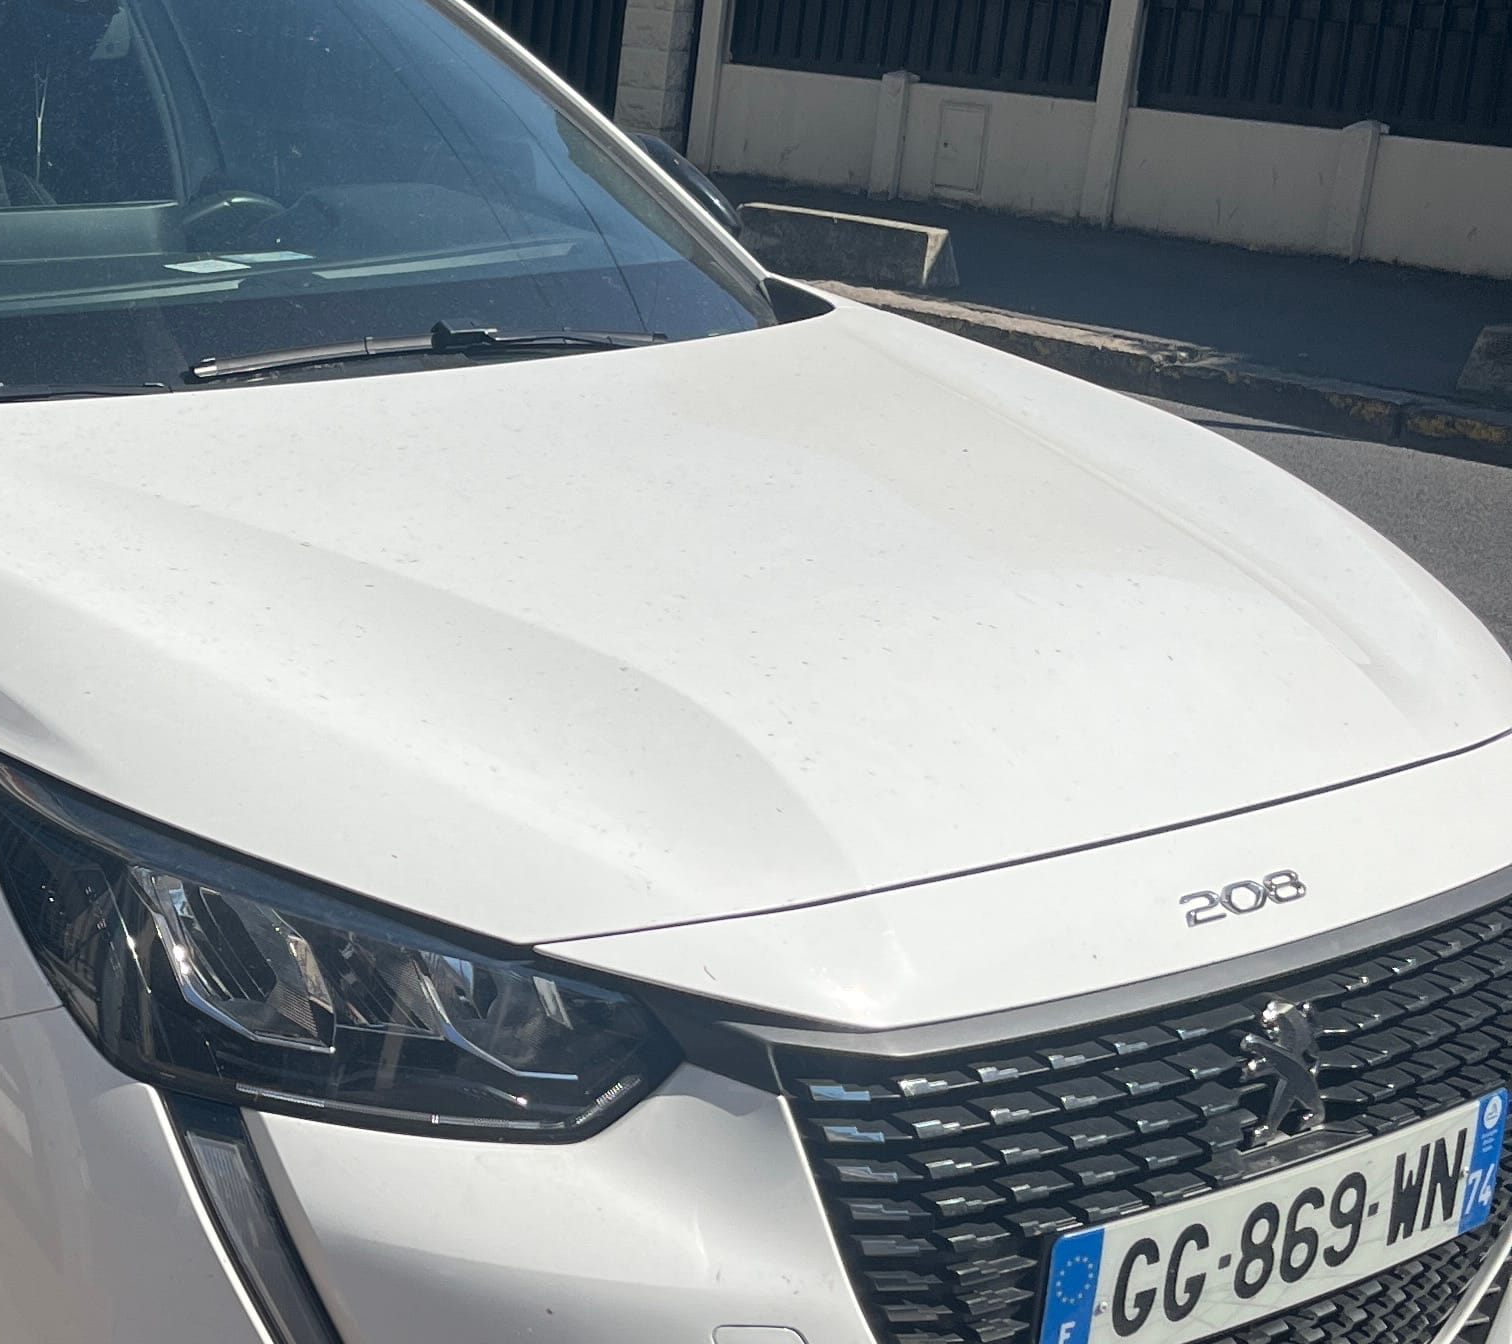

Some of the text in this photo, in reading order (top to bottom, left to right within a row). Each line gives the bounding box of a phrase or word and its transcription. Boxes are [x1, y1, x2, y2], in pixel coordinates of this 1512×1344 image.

[1179, 869, 1307, 928] 208
[1110, 1127, 1468, 1338] GG-869-WN
[1464, 1163, 1495, 1216] 74
